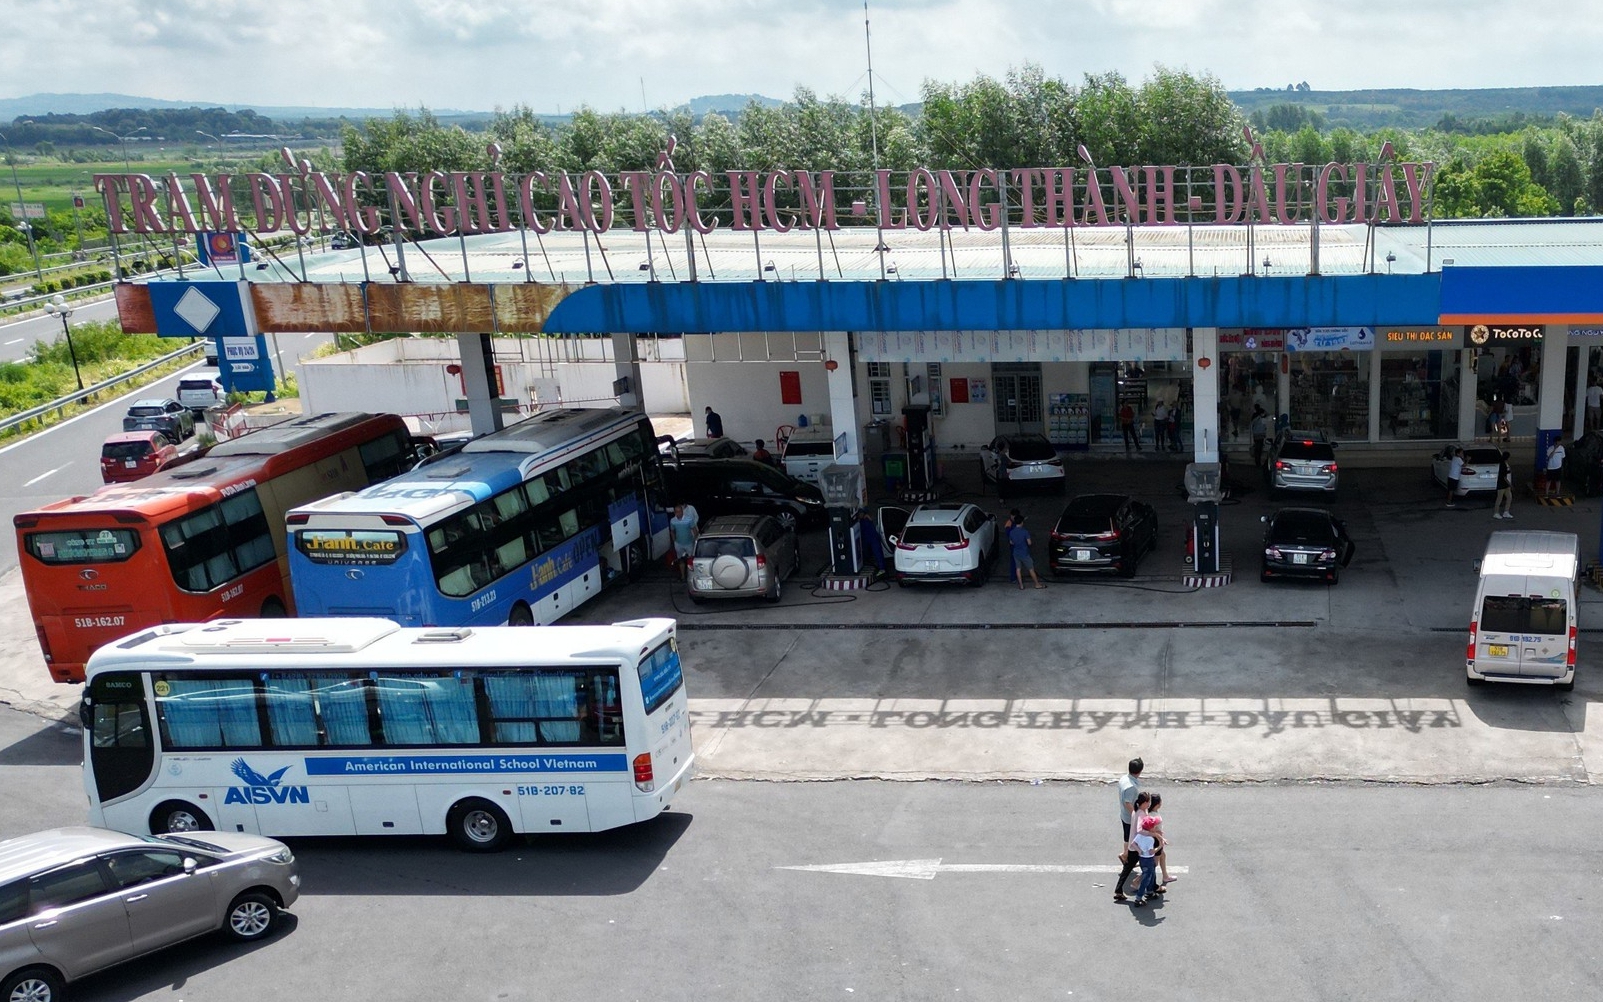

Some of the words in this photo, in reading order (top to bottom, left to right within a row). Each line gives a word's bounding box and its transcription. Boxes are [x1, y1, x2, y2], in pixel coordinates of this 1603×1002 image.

[246, 147, 380, 235] DỪNG
[385, 143, 516, 234] NGHỈ
[520, 170, 615, 234] CAO
[620, 135, 719, 234] TỐC
[726, 169, 840, 233] HCM
[875, 167, 1002, 232] LONG
[1011, 144, 1177, 227] THÀNH
[1210, 126, 1304, 225] DẦU
[1317, 141, 1434, 224] GIÂY
[75, 616, 124, 627] 51B-162.07
[345, 759, 407, 772] American
[411, 758, 495, 770] International
[500, 758, 540, 769] School
[544, 758, 598, 769] Vietnam
[224, 786, 310, 804] AISVN
